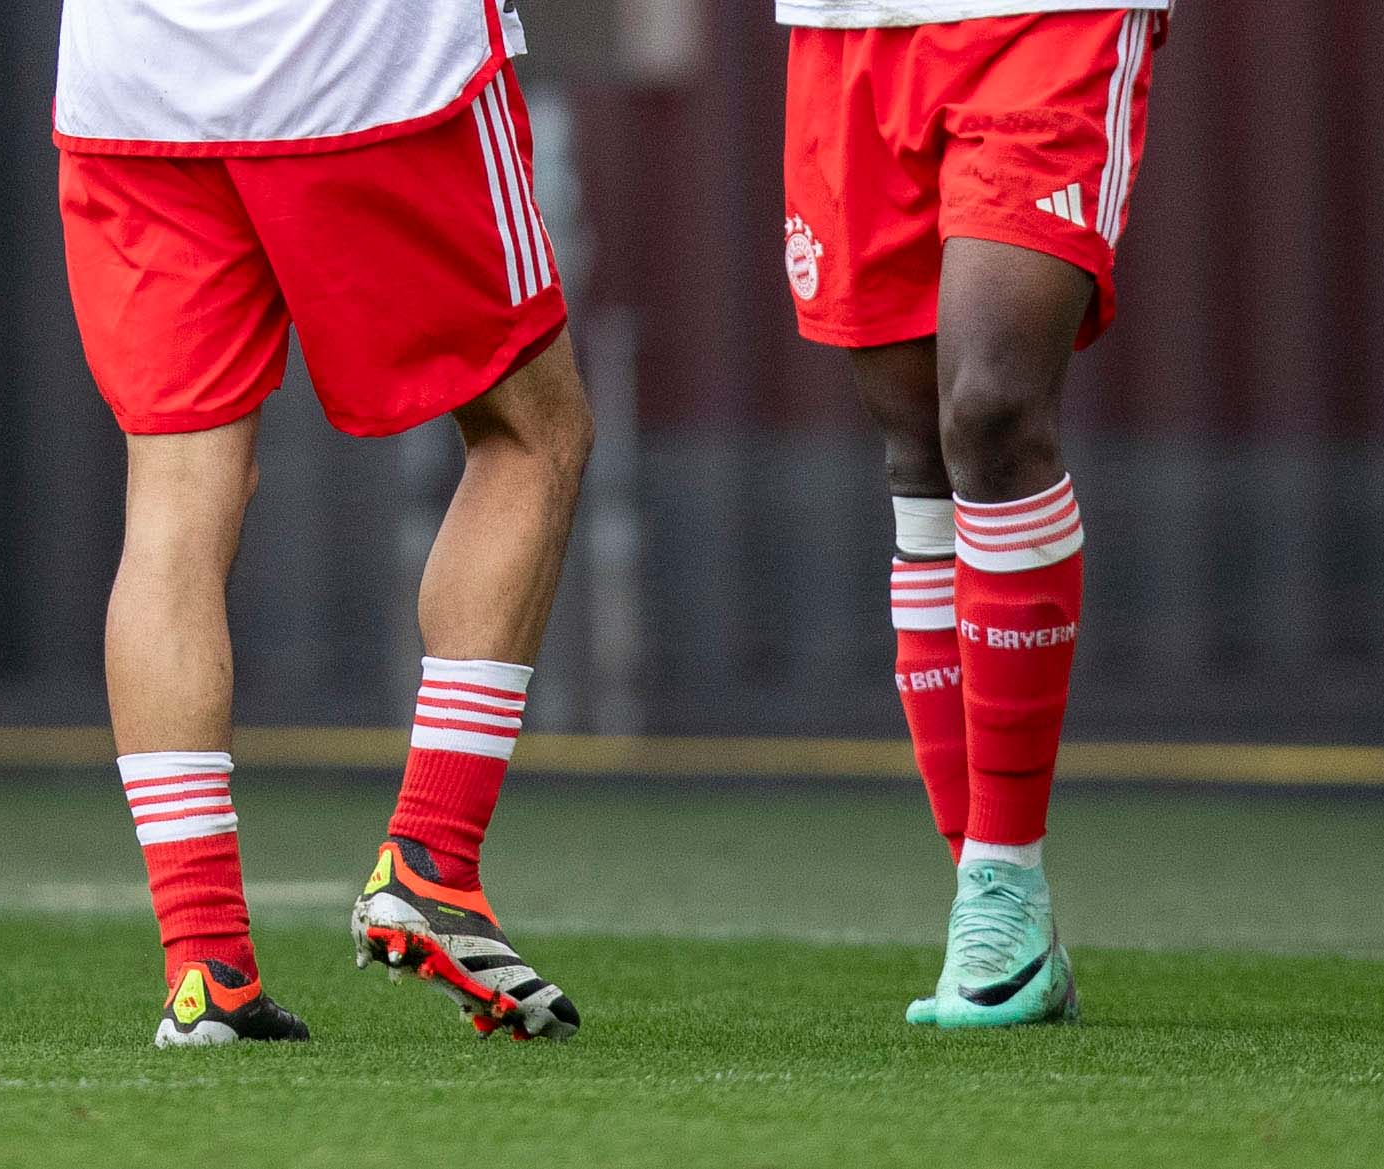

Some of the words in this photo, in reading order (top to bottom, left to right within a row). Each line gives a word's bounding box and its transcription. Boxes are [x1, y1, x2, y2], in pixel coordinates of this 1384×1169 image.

[961, 619, 981, 642] FC
[986, 621, 1077, 650] BAYERN
[910, 665, 963, 692] BAY
